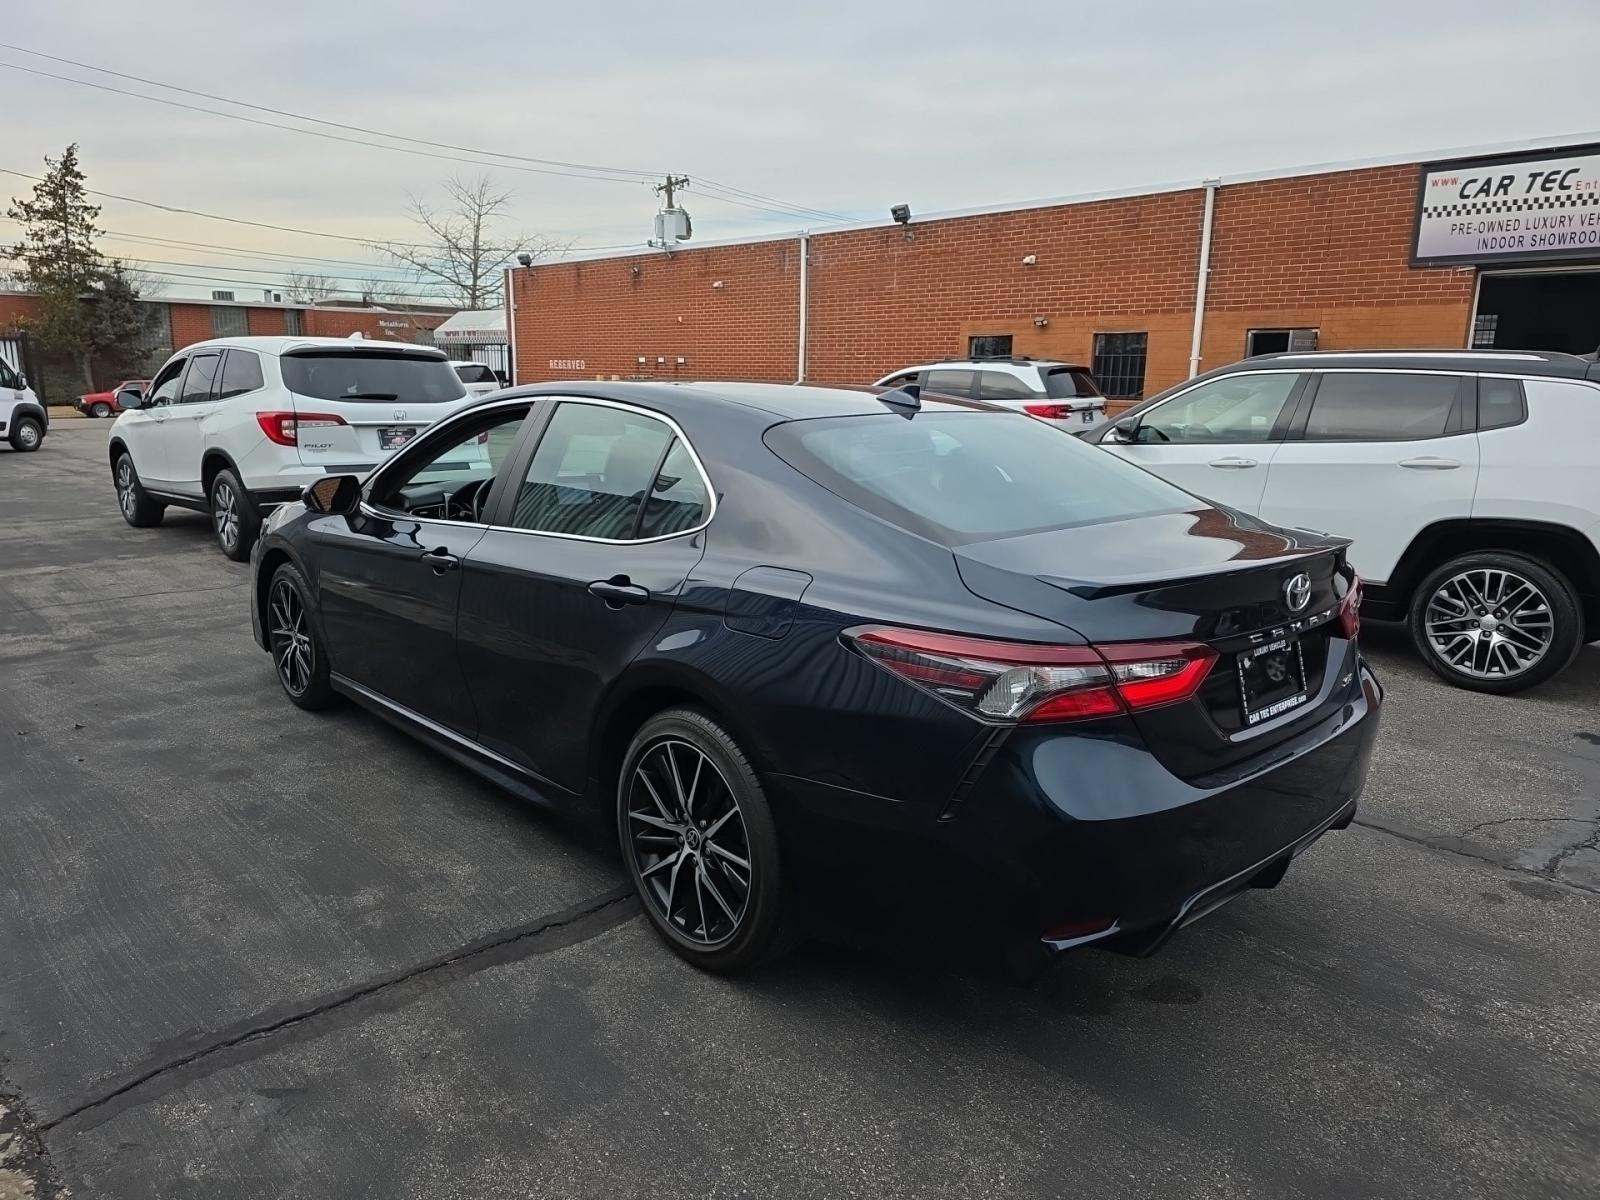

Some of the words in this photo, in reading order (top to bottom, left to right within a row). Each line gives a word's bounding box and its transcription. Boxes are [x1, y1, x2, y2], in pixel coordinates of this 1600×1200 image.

[1459, 174, 1516, 199] CAR
[1525, 168, 1581, 194] TEC
[1451, 219, 1520, 235] PRE-OWNED
[1525, 215, 1575, 231] LUXURY
[1477, 235, 1524, 250] INDOOR
[1531, 230, 1600, 247] SHOWROO
[549, 359, 585, 370] RESERVED
[1249, 610, 1331, 643] CAMRY
[1248, 712, 1260, 724] CAR
[1260, 707, 1270, 720] TEC
